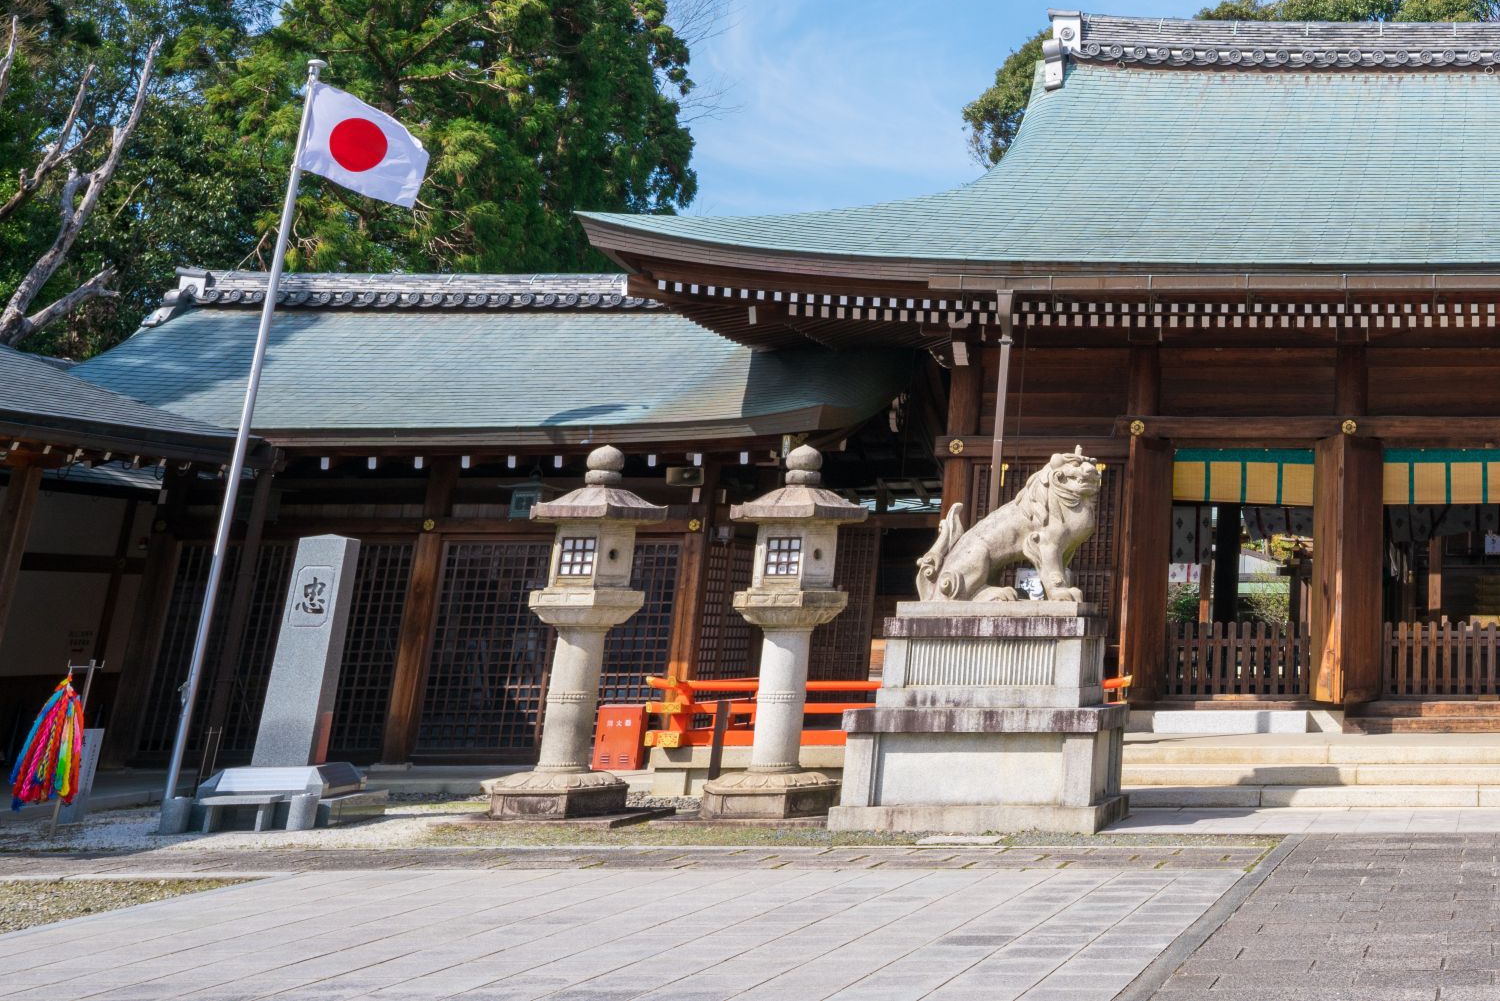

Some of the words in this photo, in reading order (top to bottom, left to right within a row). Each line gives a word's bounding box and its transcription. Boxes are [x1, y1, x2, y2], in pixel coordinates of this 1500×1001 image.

[295, 576, 327, 614] 忠
[607, 719, 632, 727] 消火器
